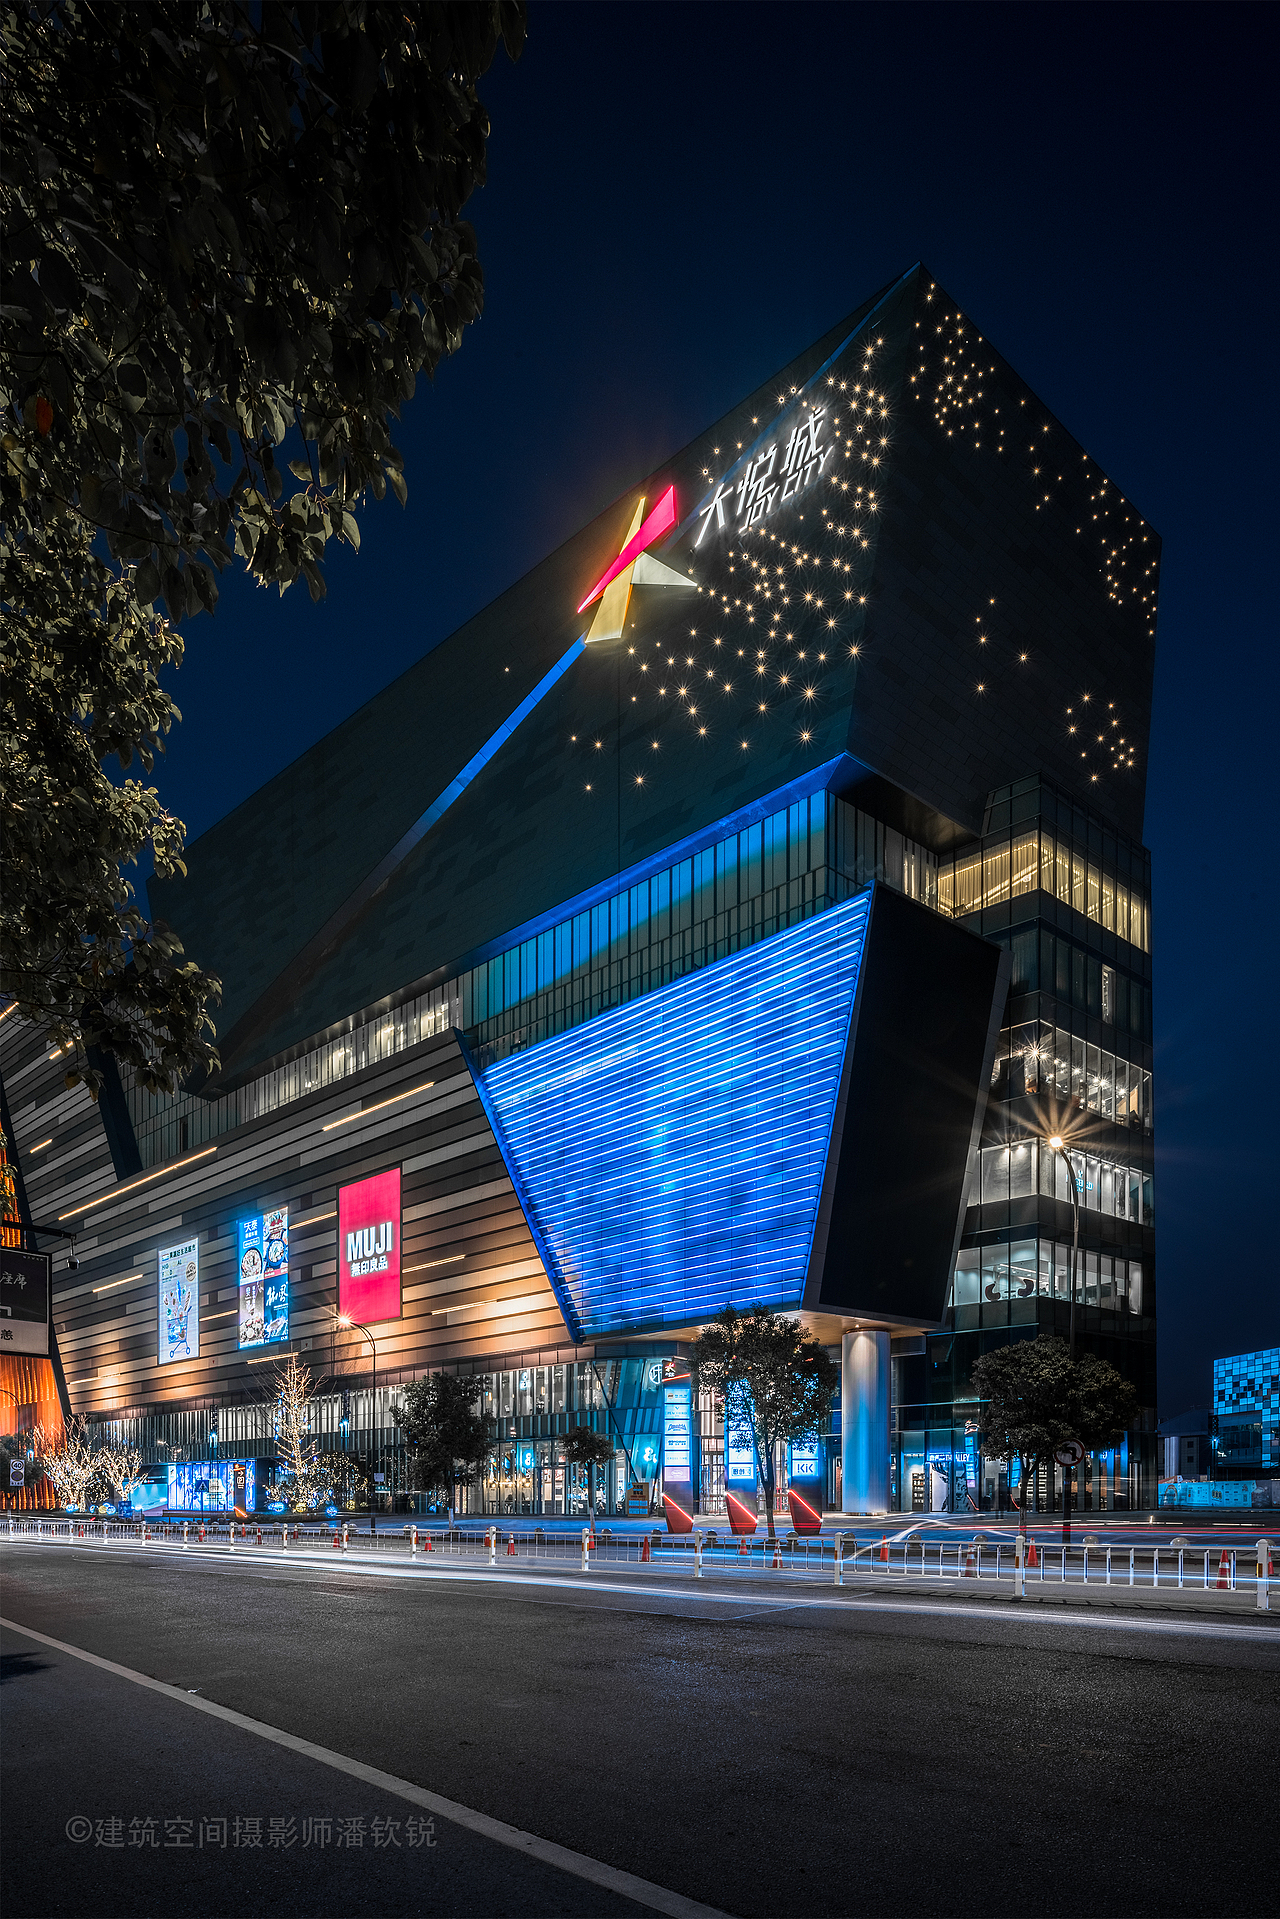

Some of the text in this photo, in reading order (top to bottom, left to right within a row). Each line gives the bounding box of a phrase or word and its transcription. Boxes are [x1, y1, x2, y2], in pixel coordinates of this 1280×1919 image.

[695, 406, 826, 548] 大悦城
[739, 445, 834, 535] JOY CITY
[346, 1221, 393, 1263] MUJI
[350, 1254, 389, 1278] 無印良品
